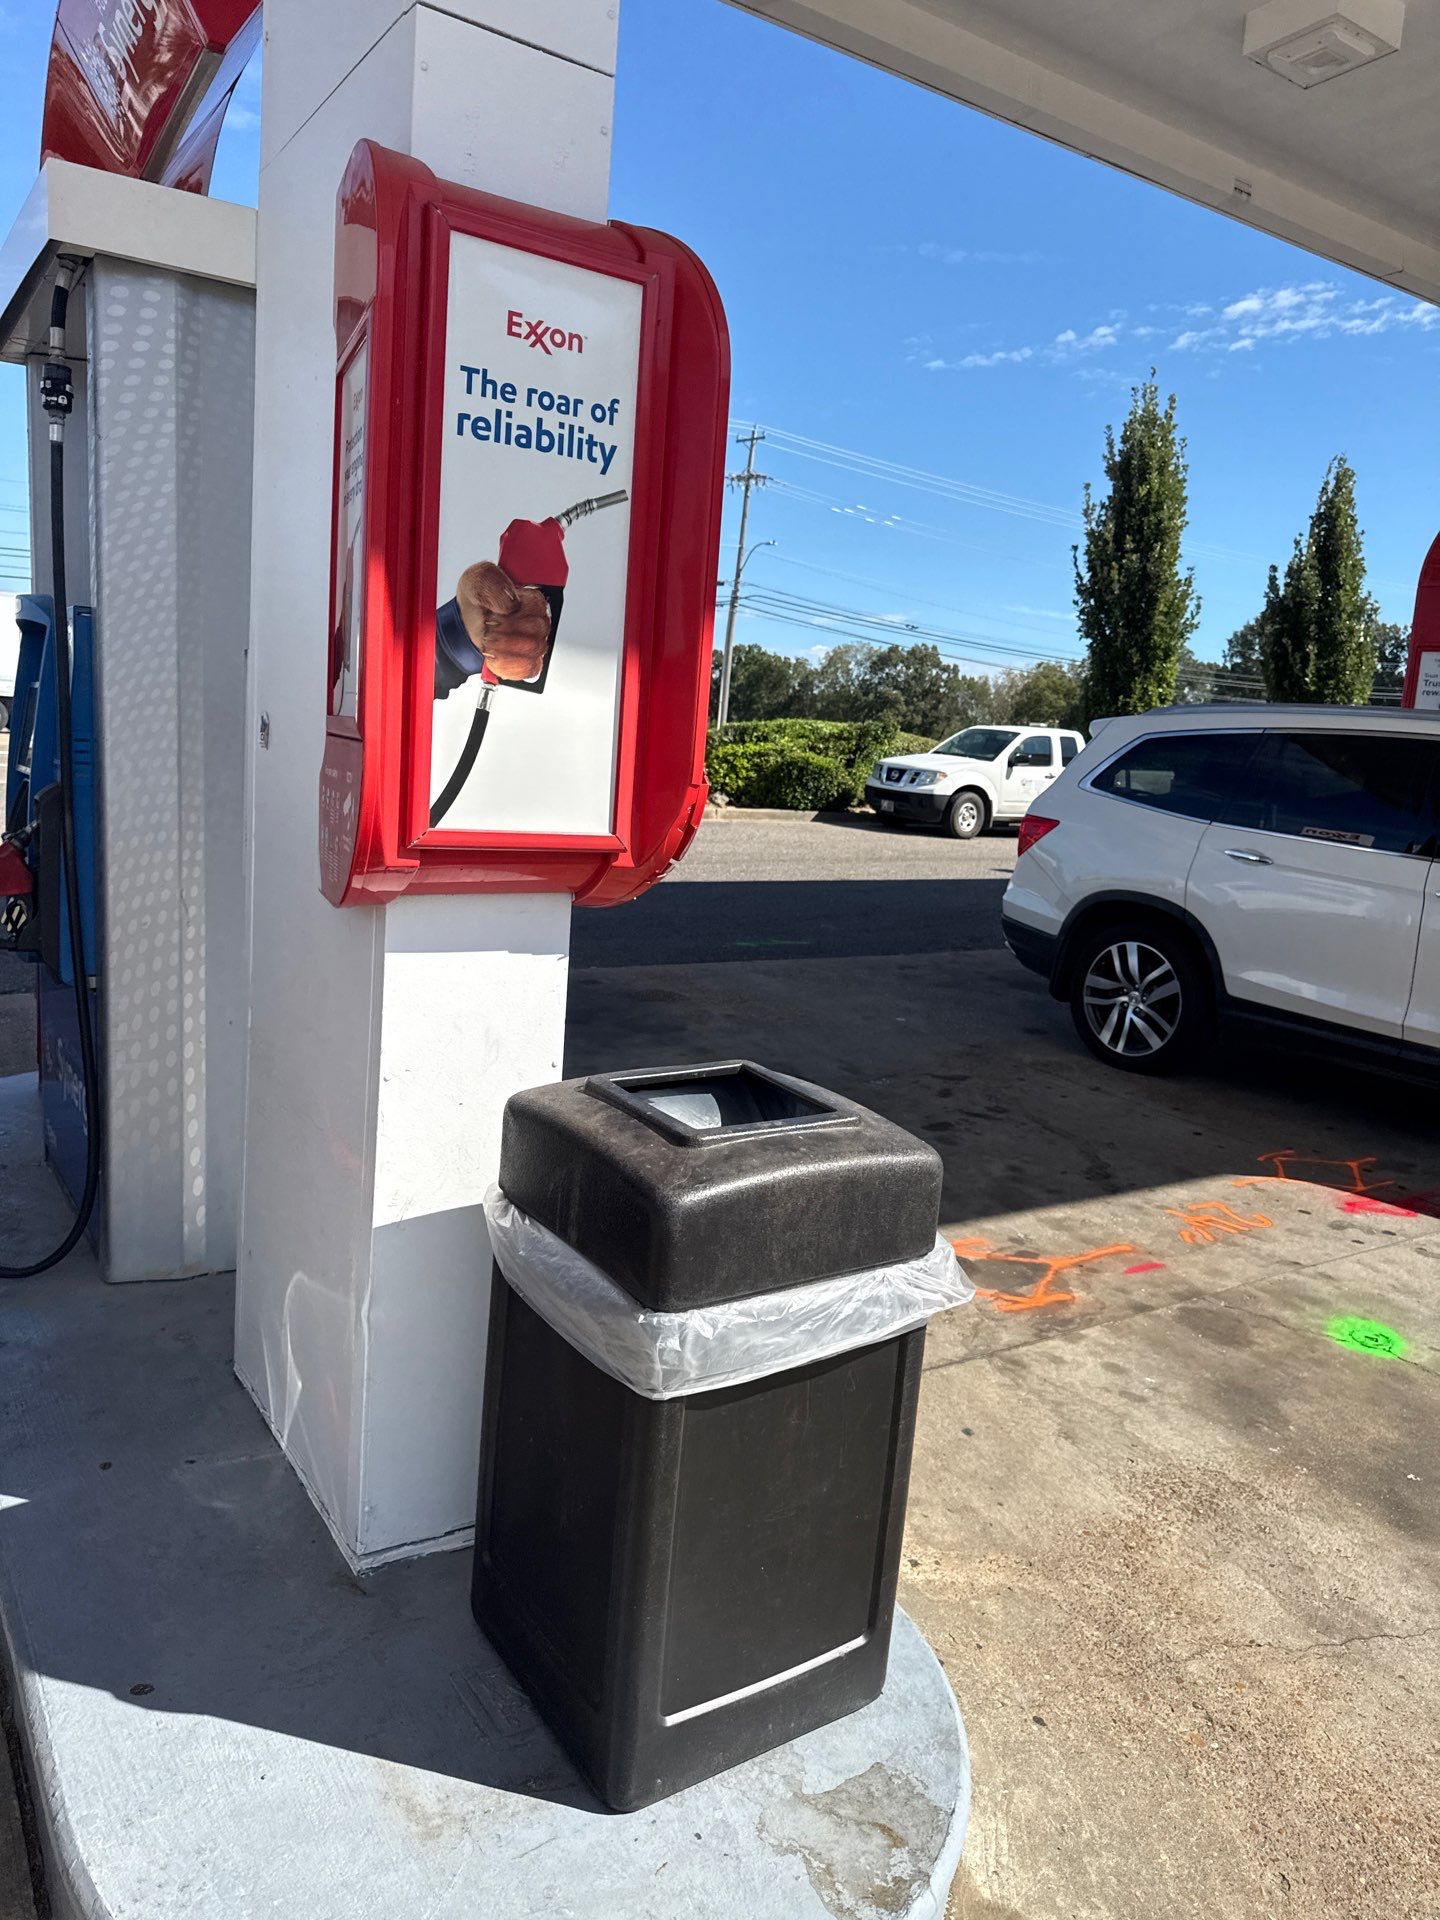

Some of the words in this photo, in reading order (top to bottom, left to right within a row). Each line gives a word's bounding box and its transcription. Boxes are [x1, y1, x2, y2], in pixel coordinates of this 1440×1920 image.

[98, 0, 168, 83] Synerg
[506, 310, 584, 355] Exxon
[460, 365, 517, 403] The
[526, 388, 583, 417] roar
[590, 398, 620, 426] of
[456, 408, 618, 475] reliability
